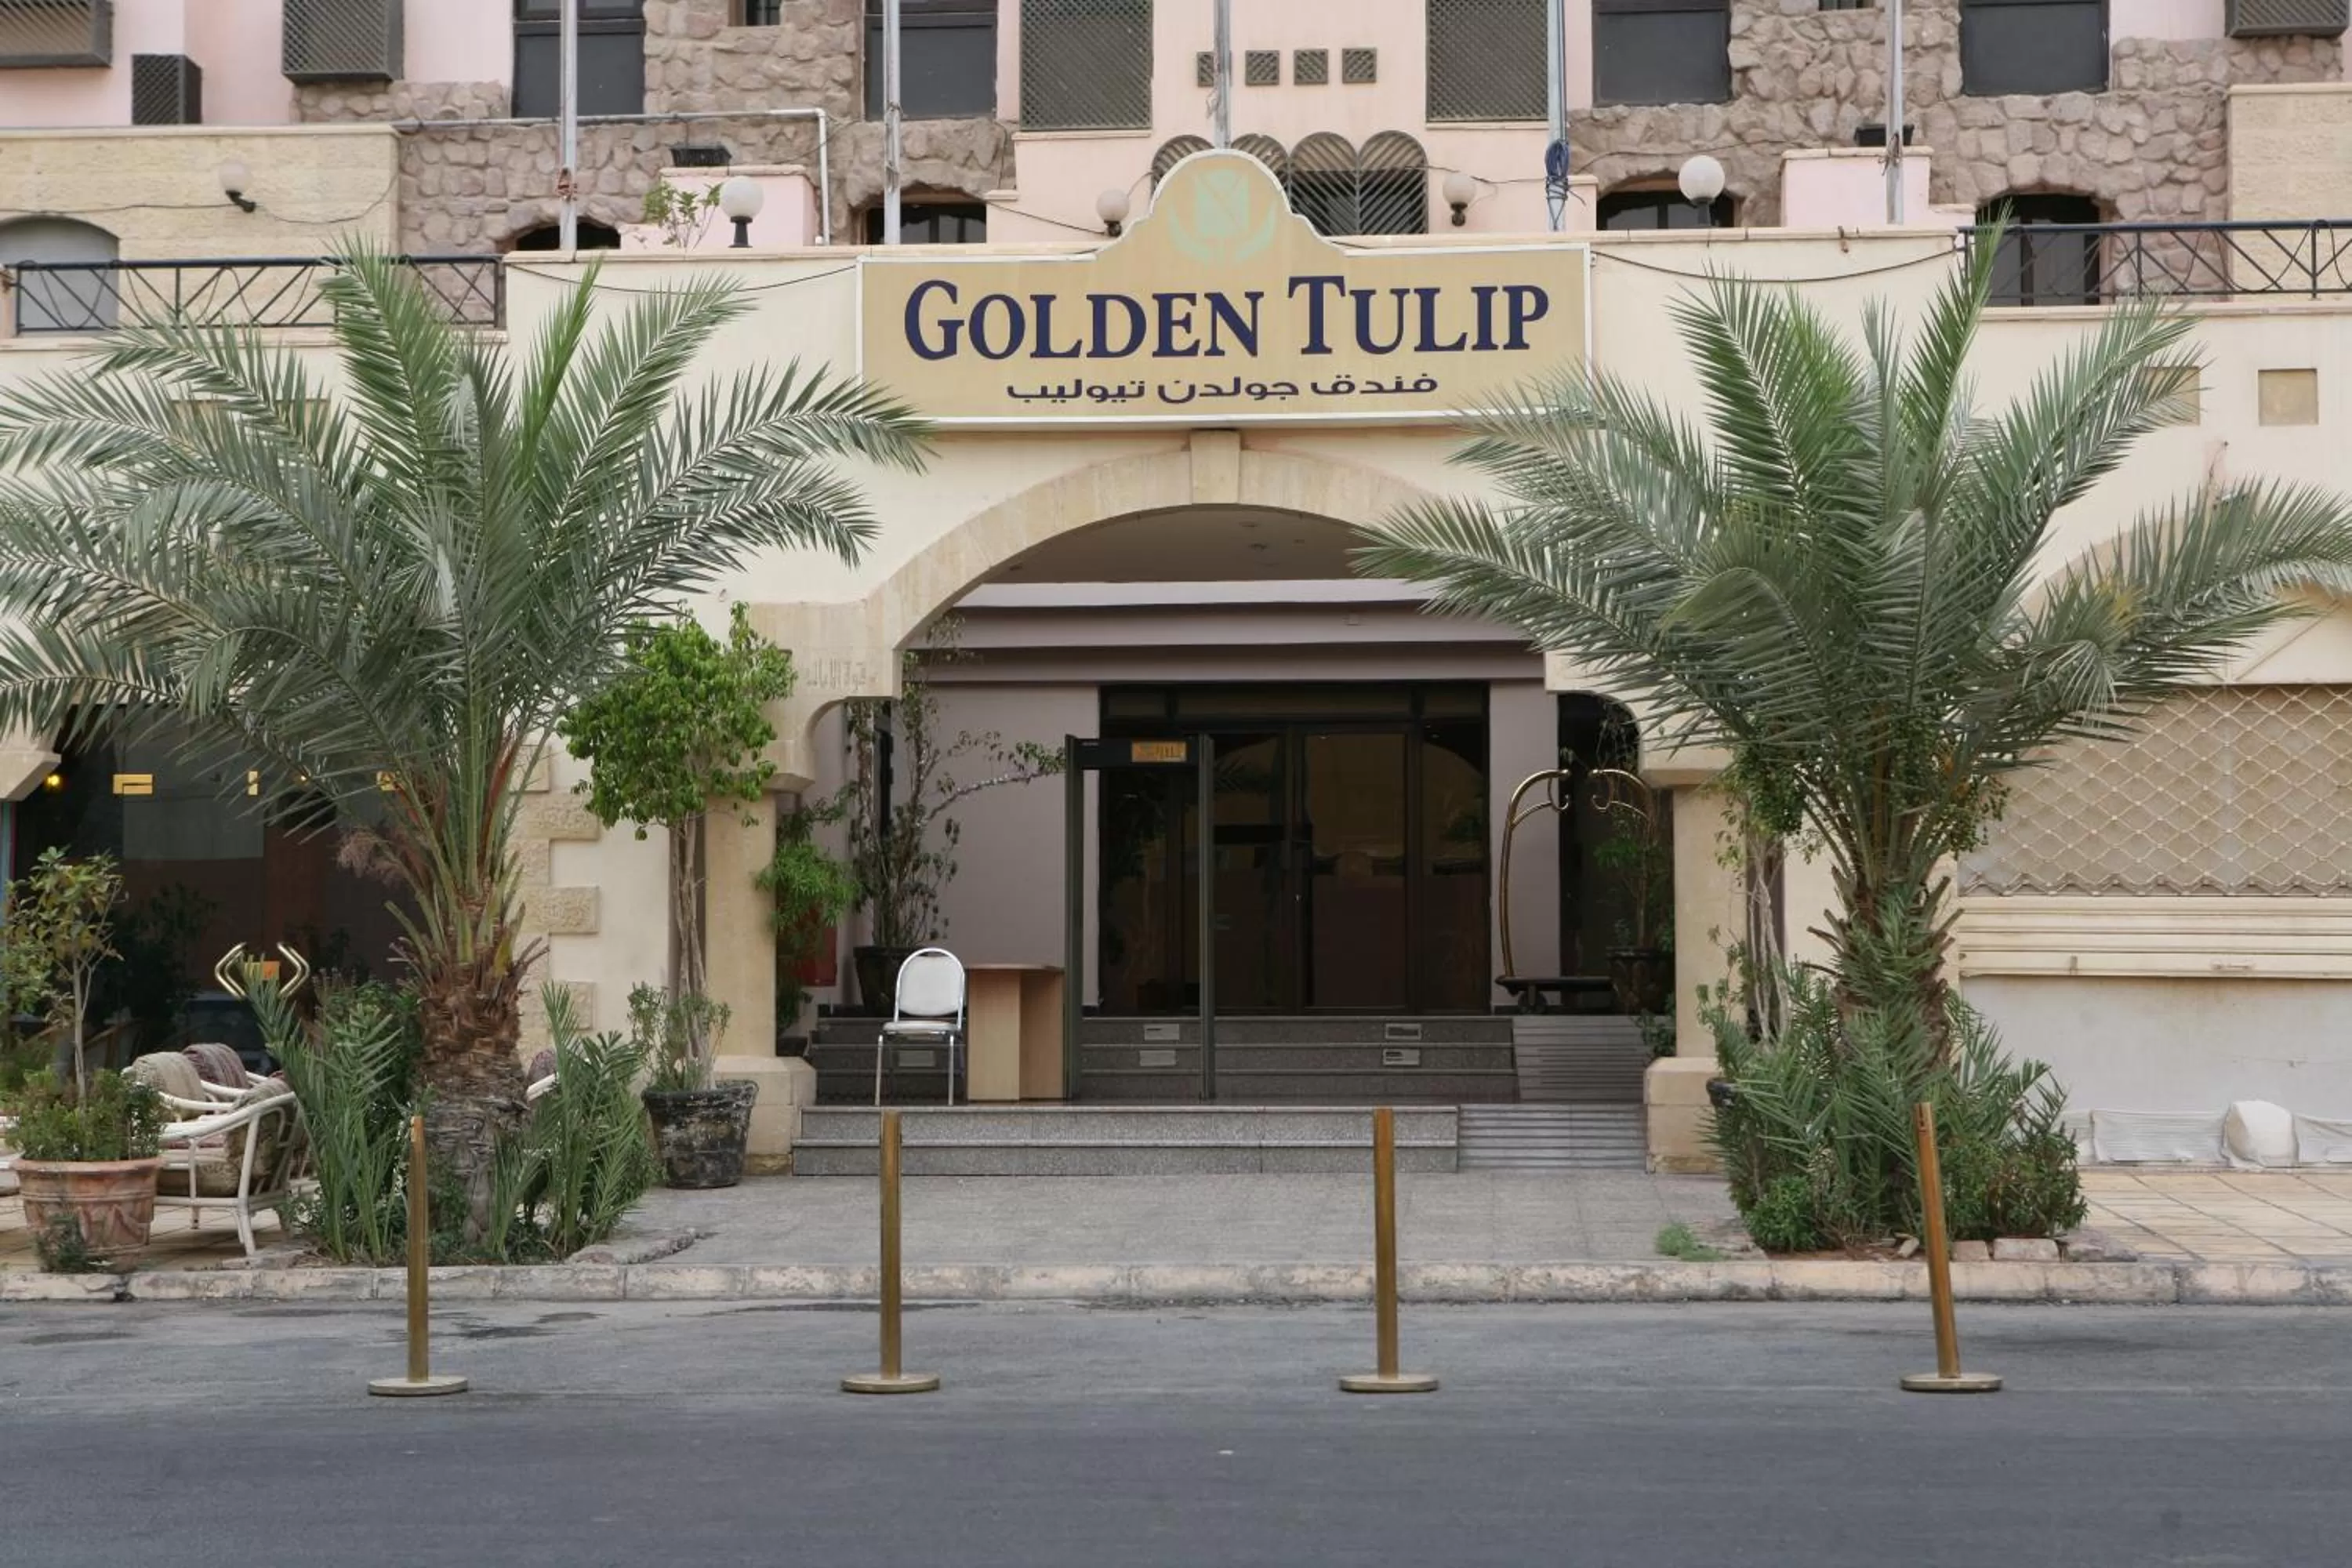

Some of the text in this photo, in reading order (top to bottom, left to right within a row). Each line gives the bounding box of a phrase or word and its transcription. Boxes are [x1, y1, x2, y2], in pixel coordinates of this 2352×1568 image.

[904, 275, 1549, 361] GOLDEN TULIP
[1007, 373, 1438, 404] فندق جولدن تيوليب
